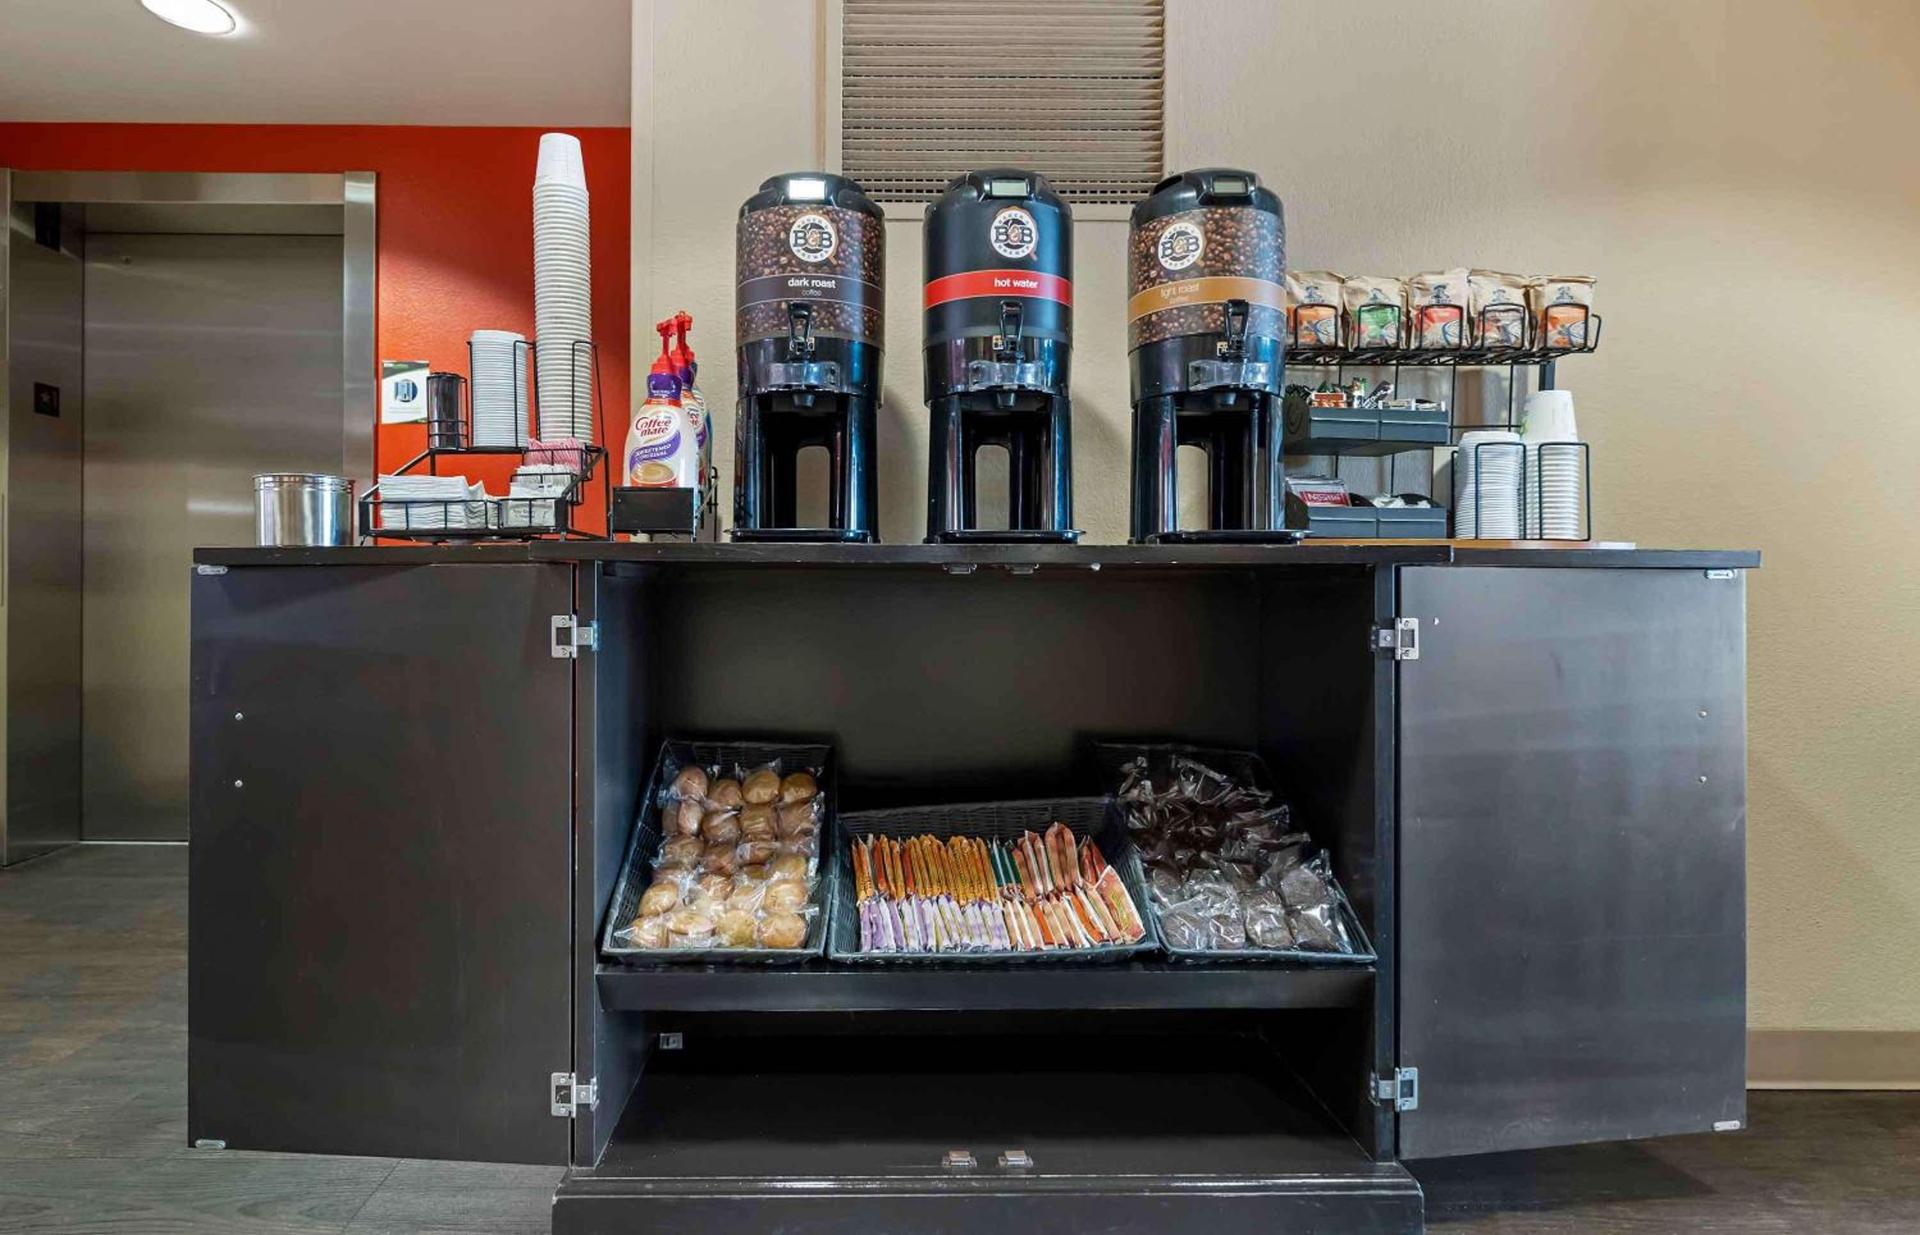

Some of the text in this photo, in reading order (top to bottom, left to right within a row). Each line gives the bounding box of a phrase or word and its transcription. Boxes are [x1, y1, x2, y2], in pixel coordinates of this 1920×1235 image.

[788, 277, 836, 289] dark roast
[993, 278, 1038, 289] hot water
[635, 416, 672, 431] Coffee
[640, 426, 668, 437] mate
